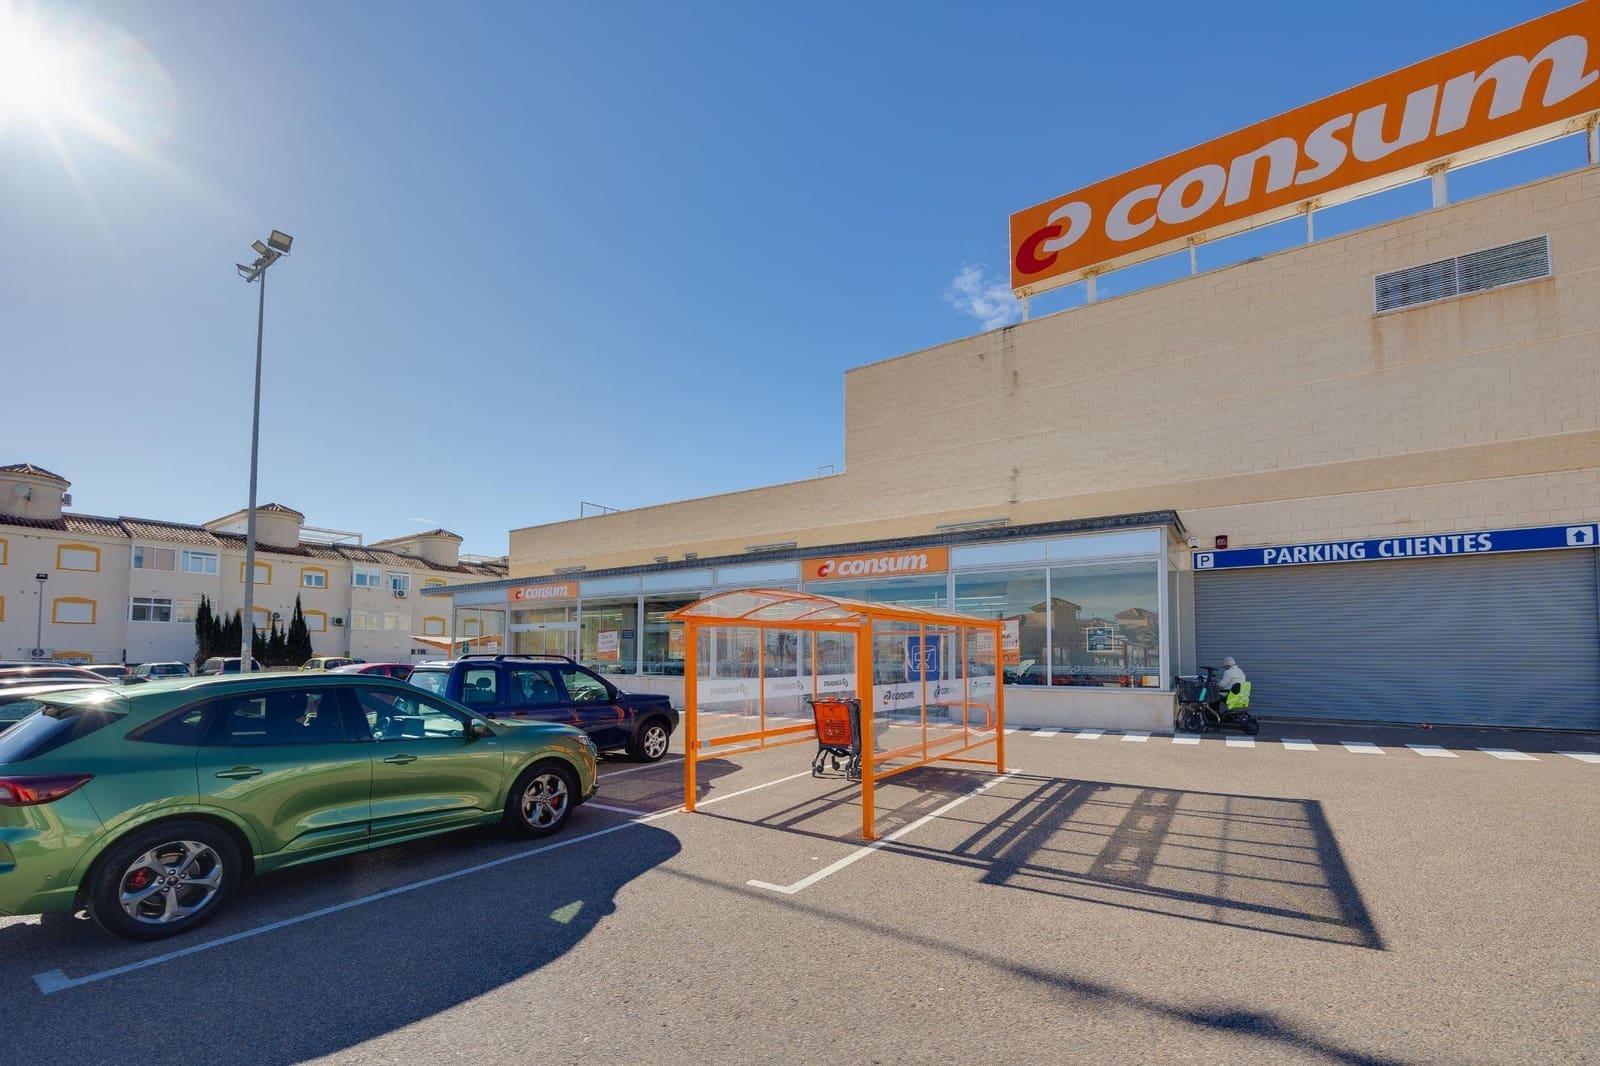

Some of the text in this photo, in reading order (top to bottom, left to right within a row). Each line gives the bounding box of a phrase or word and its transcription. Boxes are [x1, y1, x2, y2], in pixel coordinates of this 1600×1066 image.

[1105, 34, 1600, 242] consum
[1263, 542, 1366, 565] PARKING
[1378, 533, 1493, 557] CLIENTES
[837, 553, 929, 576] consum
[525, 585, 568, 599] consum
